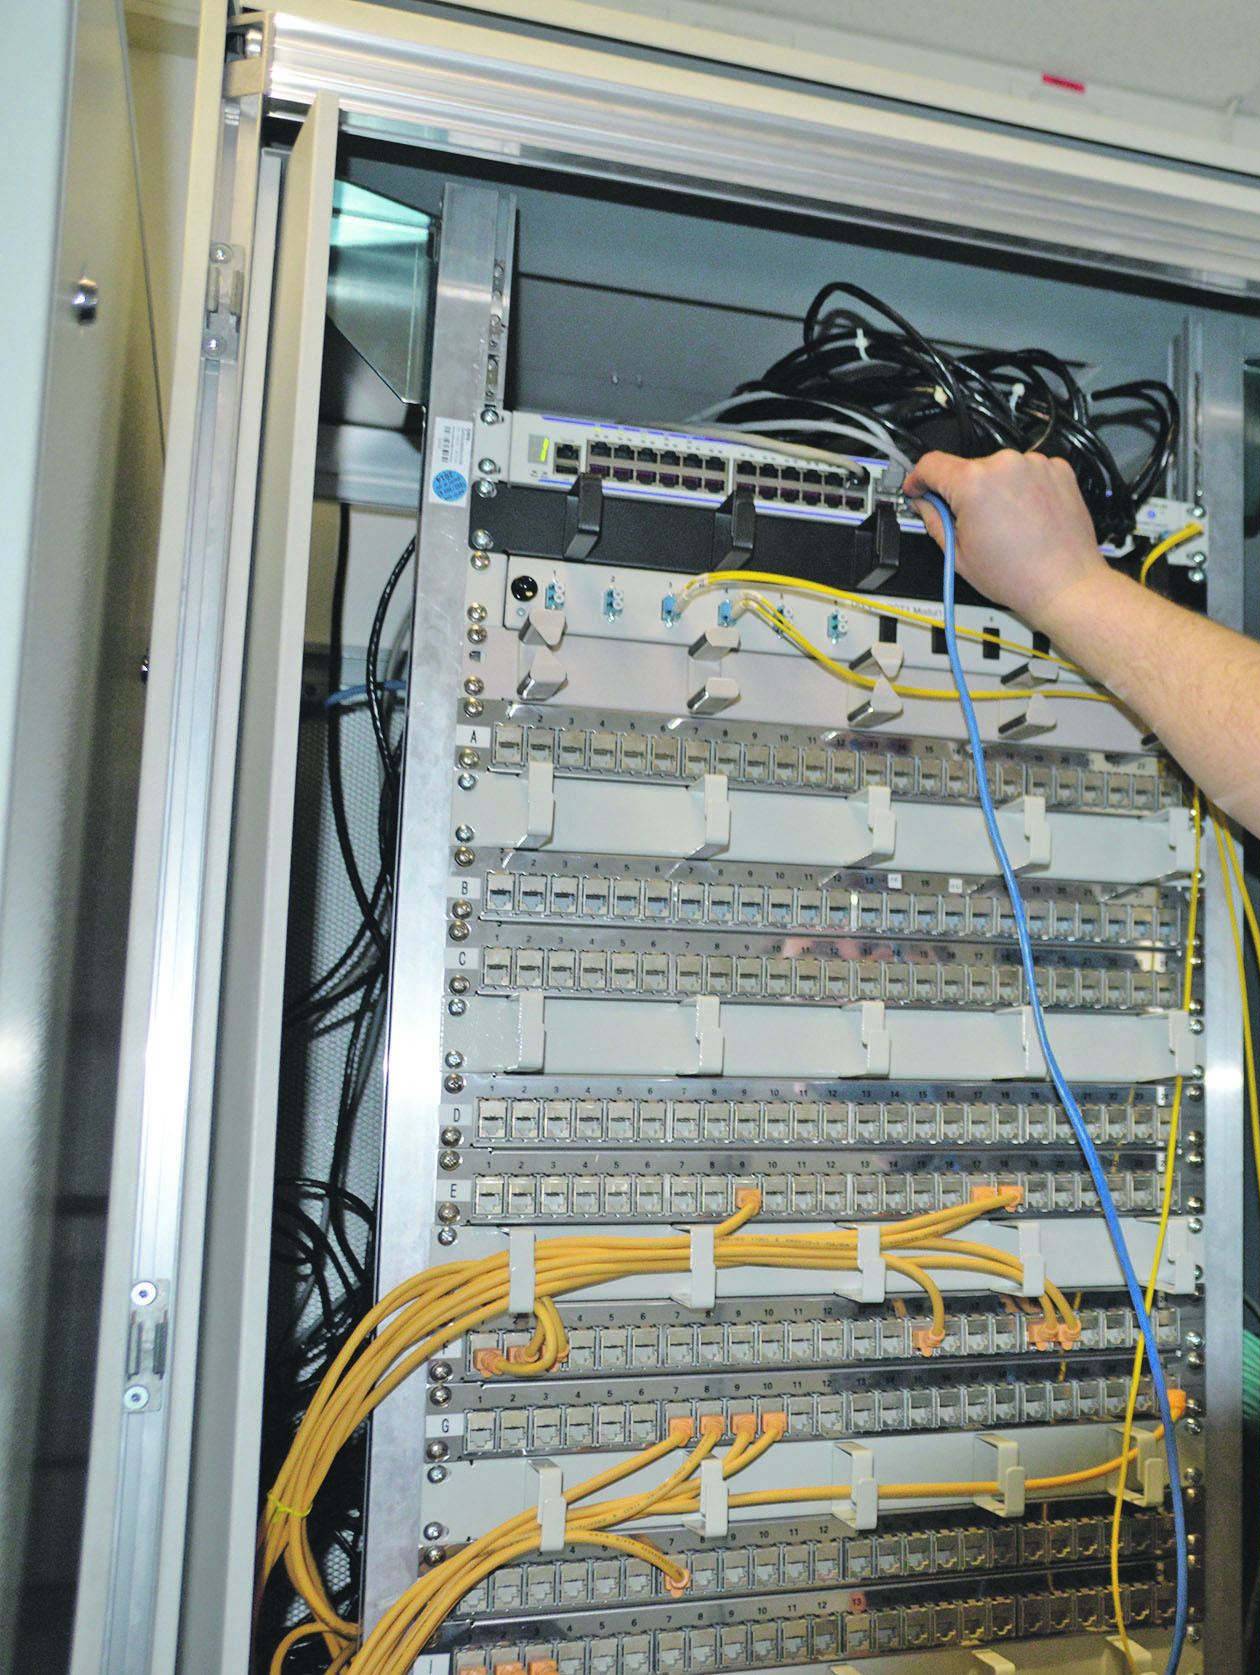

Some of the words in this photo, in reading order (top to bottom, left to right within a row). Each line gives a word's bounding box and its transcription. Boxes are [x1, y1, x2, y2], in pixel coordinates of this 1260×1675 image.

[470, 730, 477, 743] A
[779, 734, 789, 743] 10
[808, 736, 817, 744] 11
[775, 871, 785, 879] 10
[804, 873, 813, 881] 11
[461, 881, 468, 895] B
[772, 944, 782, 953] 10
[458, 951, 466, 966] C
[770, 1089, 779, 1097] 10
[799, 1089, 808, 1097] 11
[828, 1090, 838, 1098] 12
[861, 1090, 871, 1098] 13
[890, 1090, 900, 1098] 14
[453, 1108, 461, 1123] D
[768, 1161, 778, 1169] 10
[826, 1161, 836, 1169] 12
[860, 1160, 870, 1169] 13
[889, 1161, 898, 1169] 14
[450, 1183, 457, 1198] E
[764, 1308, 774, 1317] 10
[823, 1307, 833, 1316] 12
[763, 1382, 773, 1390] 10
[823, 1379, 832, 1388] 12
[441, 1418, 449, 1434] G
[759, 1530, 770, 1539] 10
[789, 1528, 799, 1536] 11
[819, 1525, 829, 1534] 12
[757, 1606, 768, 1615] 10
[787, 1604, 797, 1612] 11
[817, 1601, 827, 1609] 12
[852, 1597, 862, 1606] 13
